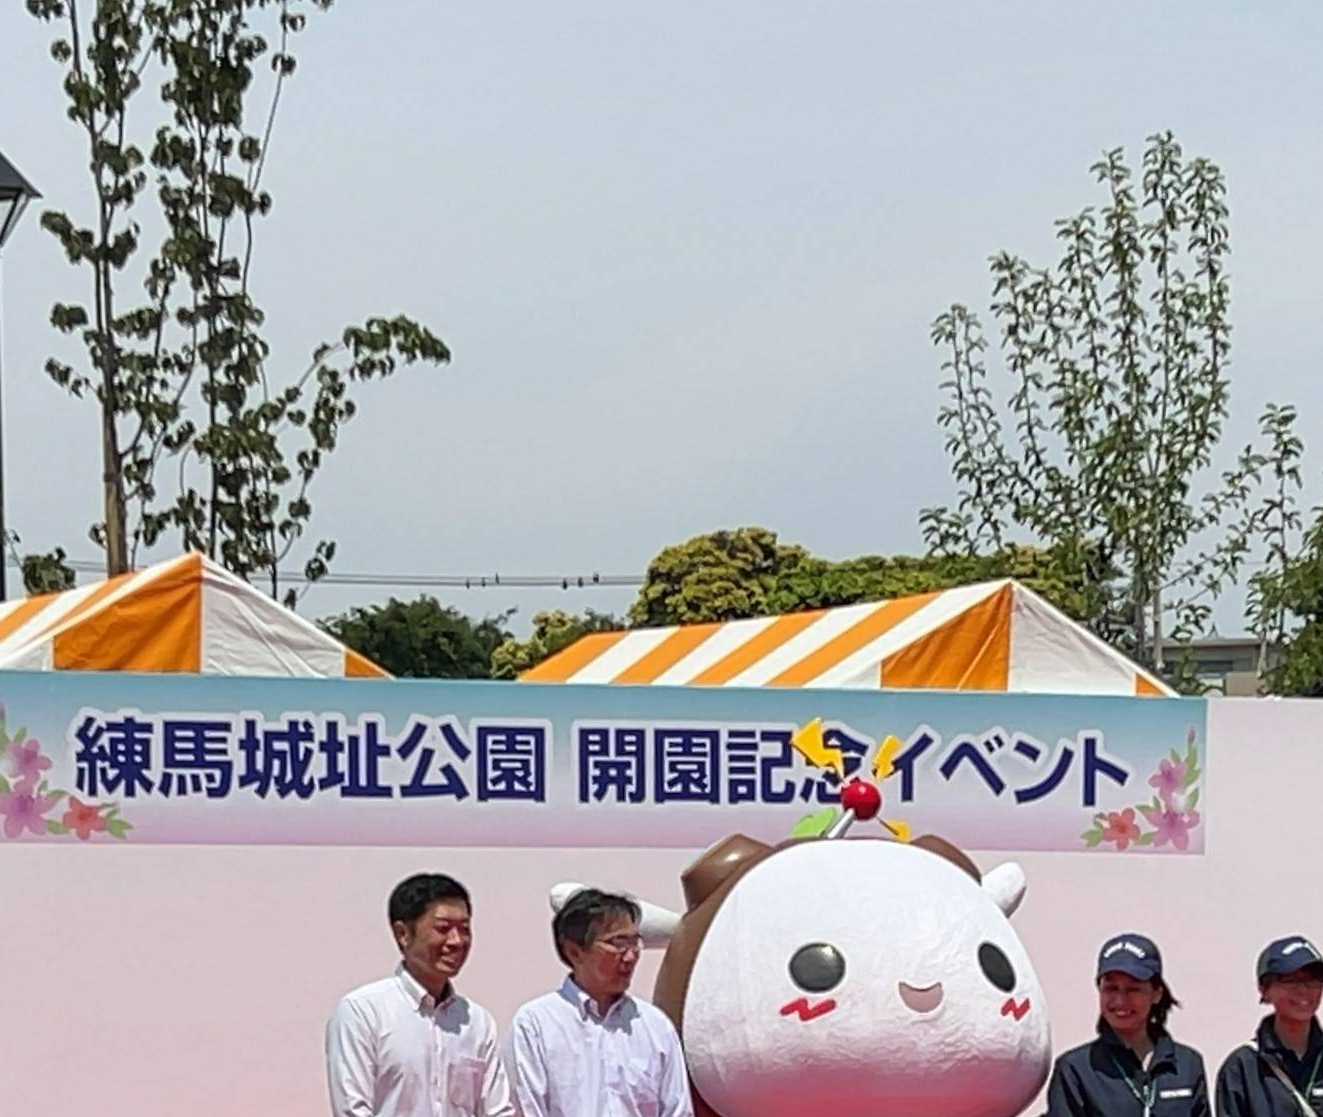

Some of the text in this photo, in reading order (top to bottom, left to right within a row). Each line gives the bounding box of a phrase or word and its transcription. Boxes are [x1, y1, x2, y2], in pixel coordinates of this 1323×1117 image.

[76, 716, 1129, 808] 練馬城址公園 開園記念イベント
